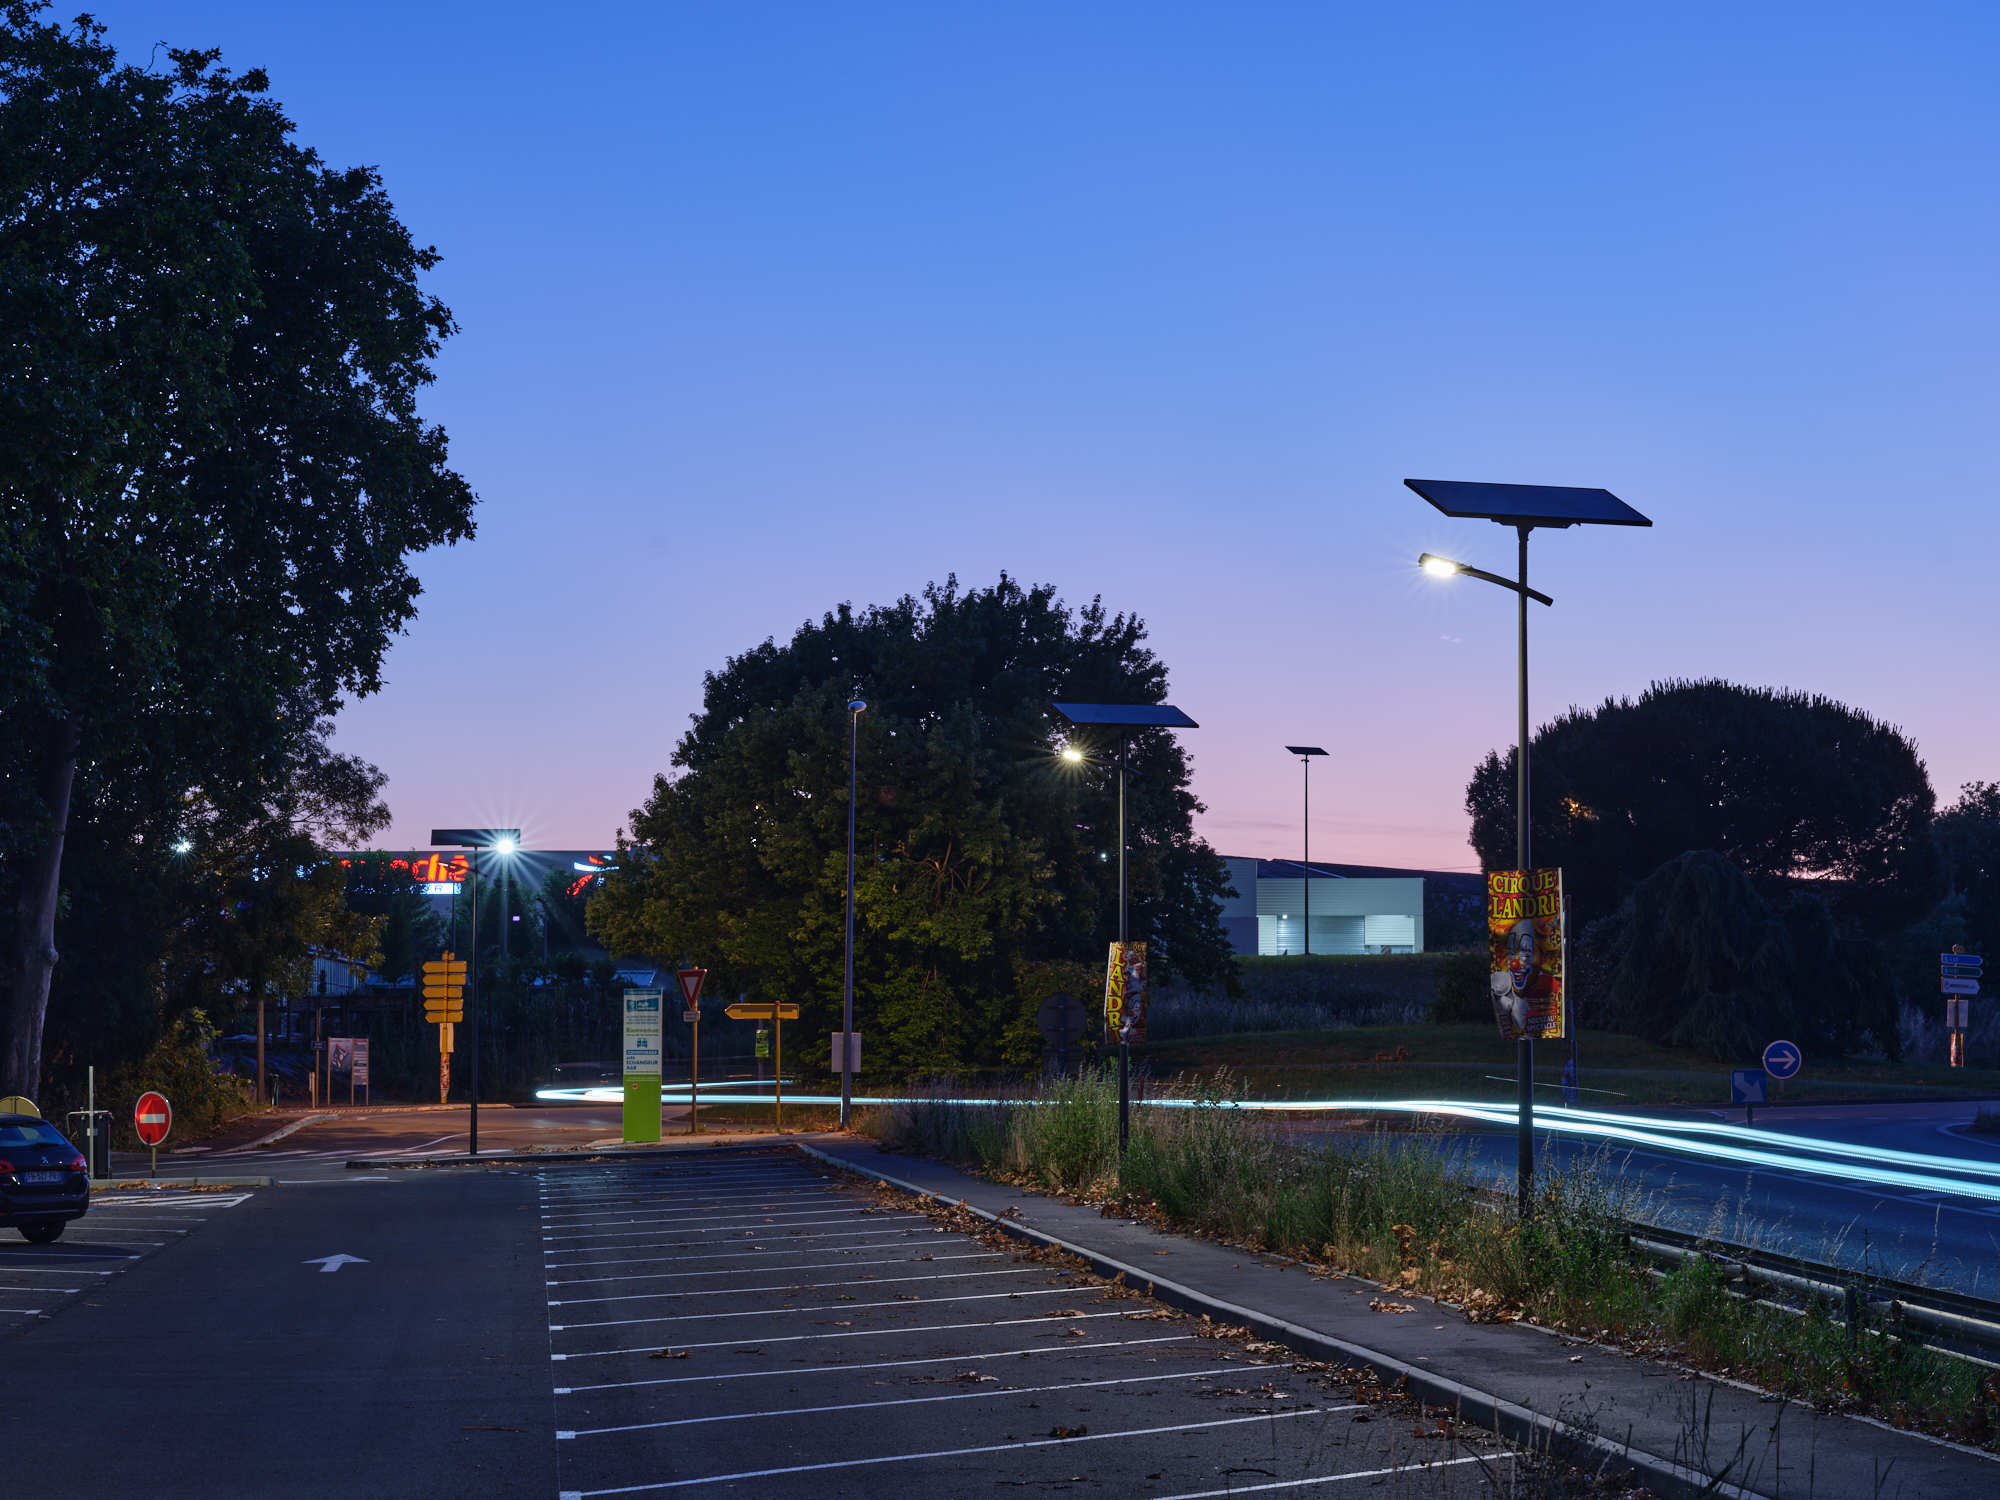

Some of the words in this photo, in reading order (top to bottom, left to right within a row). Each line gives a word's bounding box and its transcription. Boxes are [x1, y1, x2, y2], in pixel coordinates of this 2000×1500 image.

[1492, 870, 1555, 897] CIRQUE
[1491, 892, 1557, 919] LANDRI
[1121, 942, 1146, 952] CIRQUE
[1107, 948, 1126, 1043] LANDRI
[1527, 1015, 1555, 1025] NOUVEAU
[1526, 1021, 1557, 1032] SPECTACLE
[27, 1172, 57, 1181] FH-527-PR
